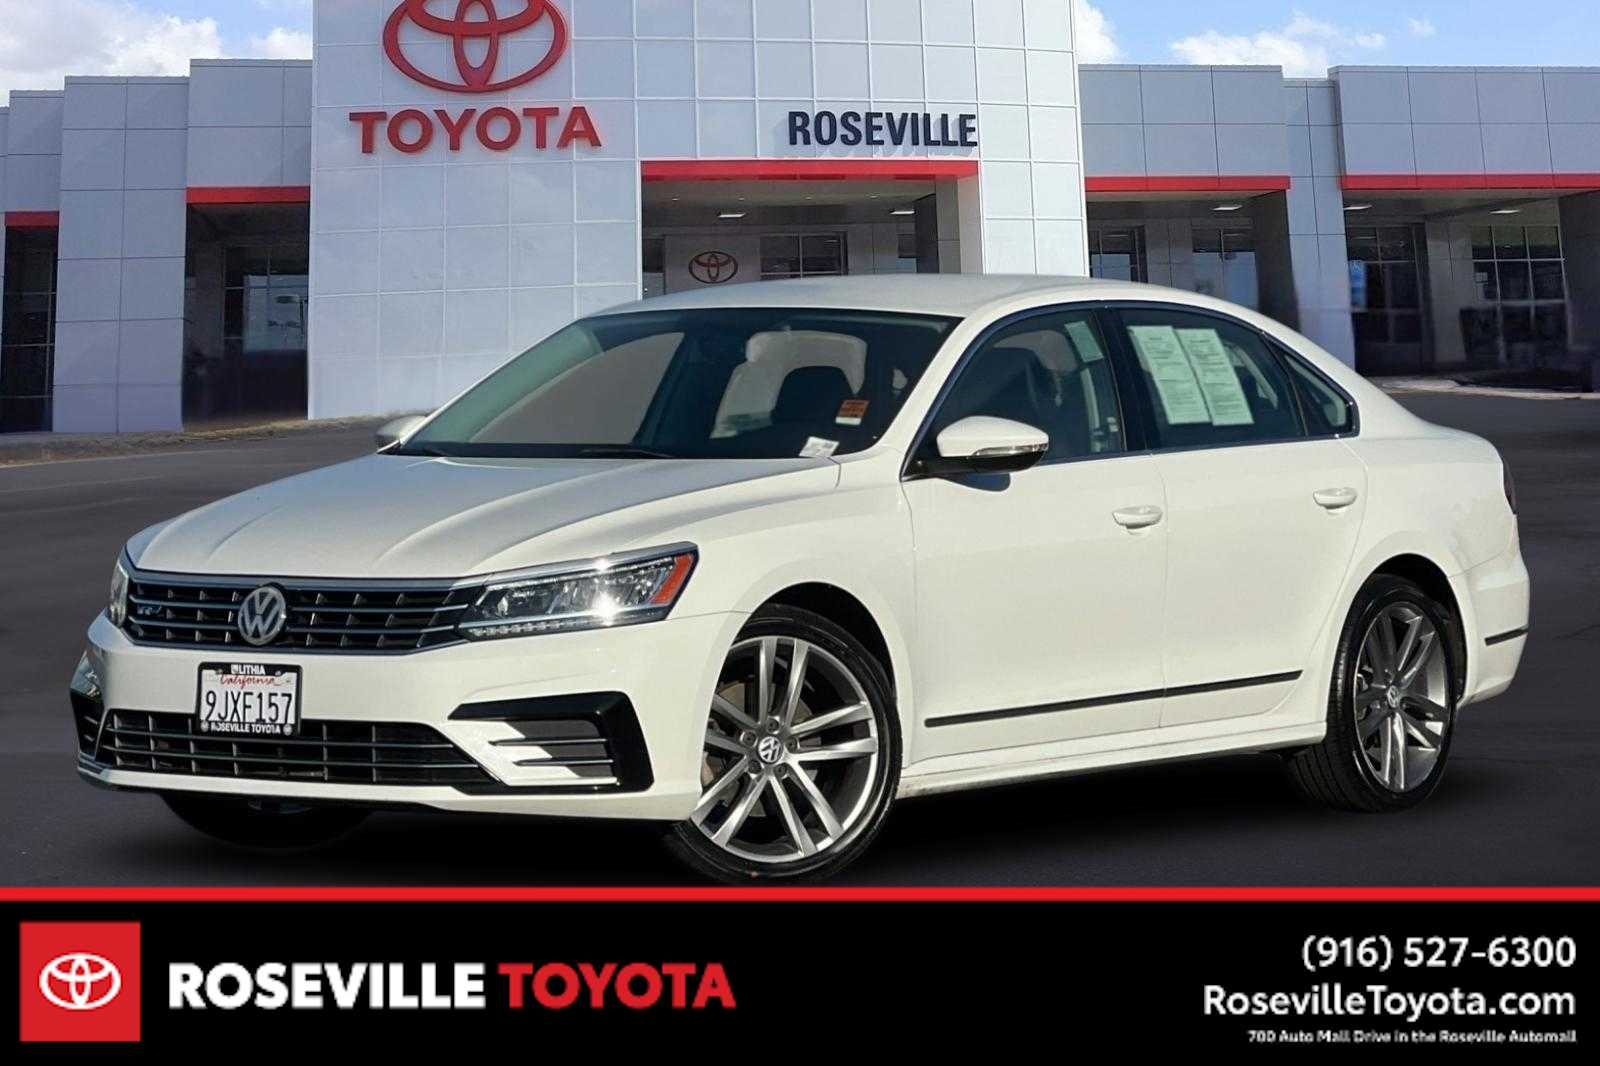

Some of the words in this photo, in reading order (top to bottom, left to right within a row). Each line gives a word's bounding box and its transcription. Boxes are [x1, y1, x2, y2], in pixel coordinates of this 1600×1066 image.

[349, 106, 602, 153] TOYOTA
[788, 110, 978, 147] ROSEVILLE
[238, 665, 266, 675] LITHIA
[205, 690, 293, 725] 9JXF157
